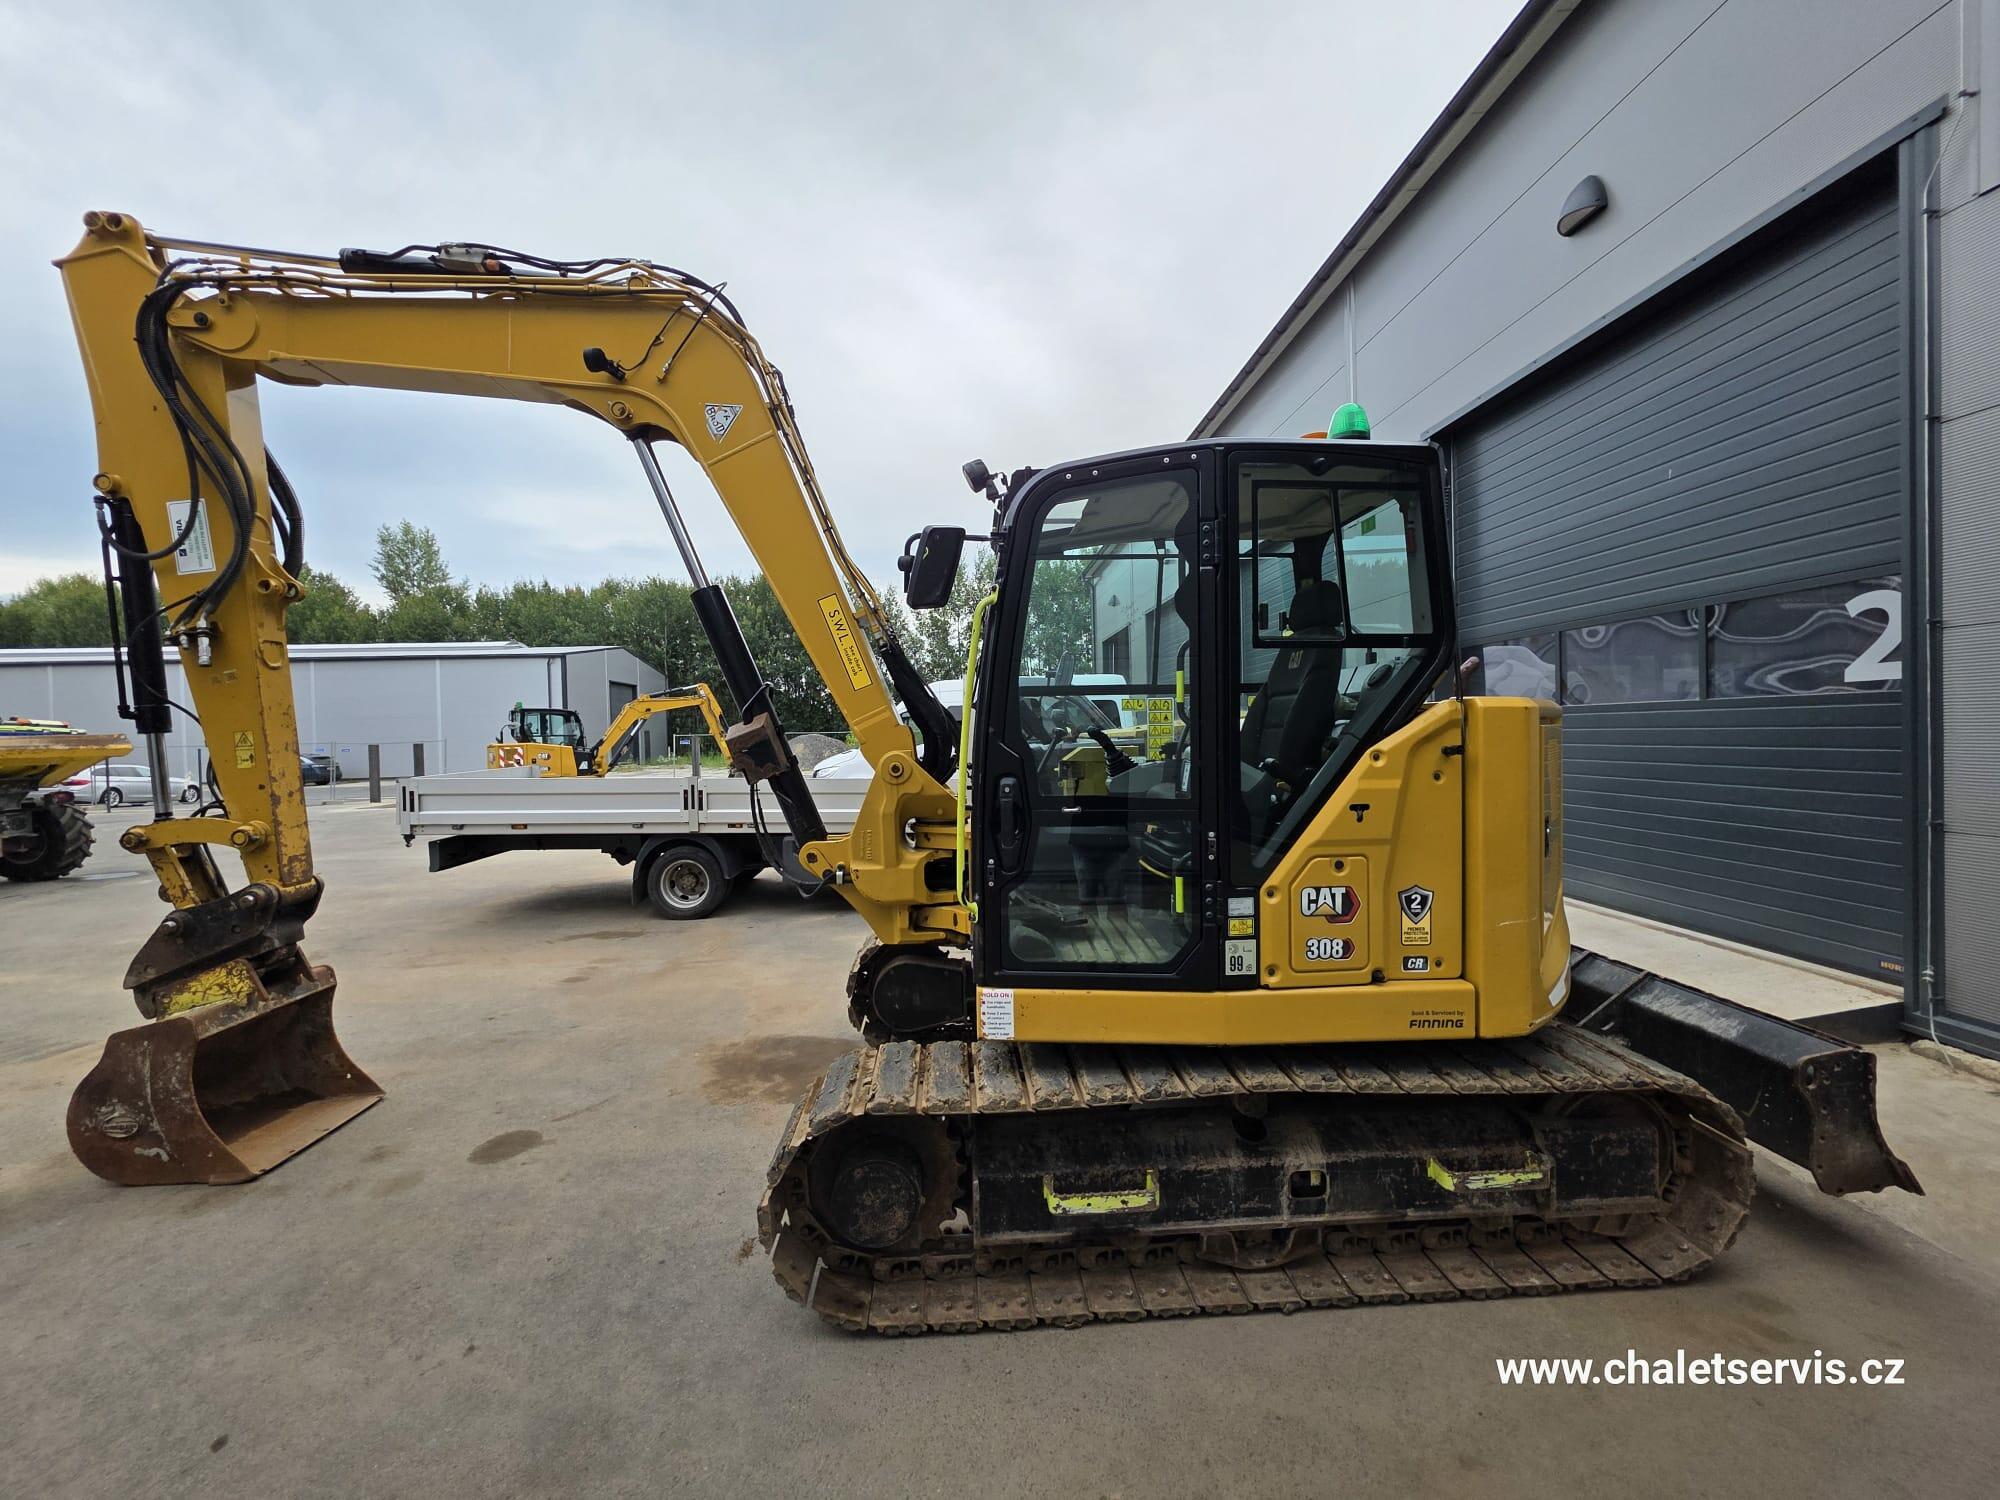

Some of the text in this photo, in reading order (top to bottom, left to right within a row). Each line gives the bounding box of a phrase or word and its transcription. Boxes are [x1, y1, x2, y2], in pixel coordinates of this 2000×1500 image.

[829, 609, 849, 646] S.W.L.
[1844, 589, 1902, 682] 2
[1301, 887, 1346, 916] CAT
[1410, 894, 1422, 909] 2
[1306, 938, 1344, 959] 308
[1230, 955, 1243, 972] 99
[1407, 958, 1424, 969] CR
[1409, 1019, 1464, 1028] FINNING
